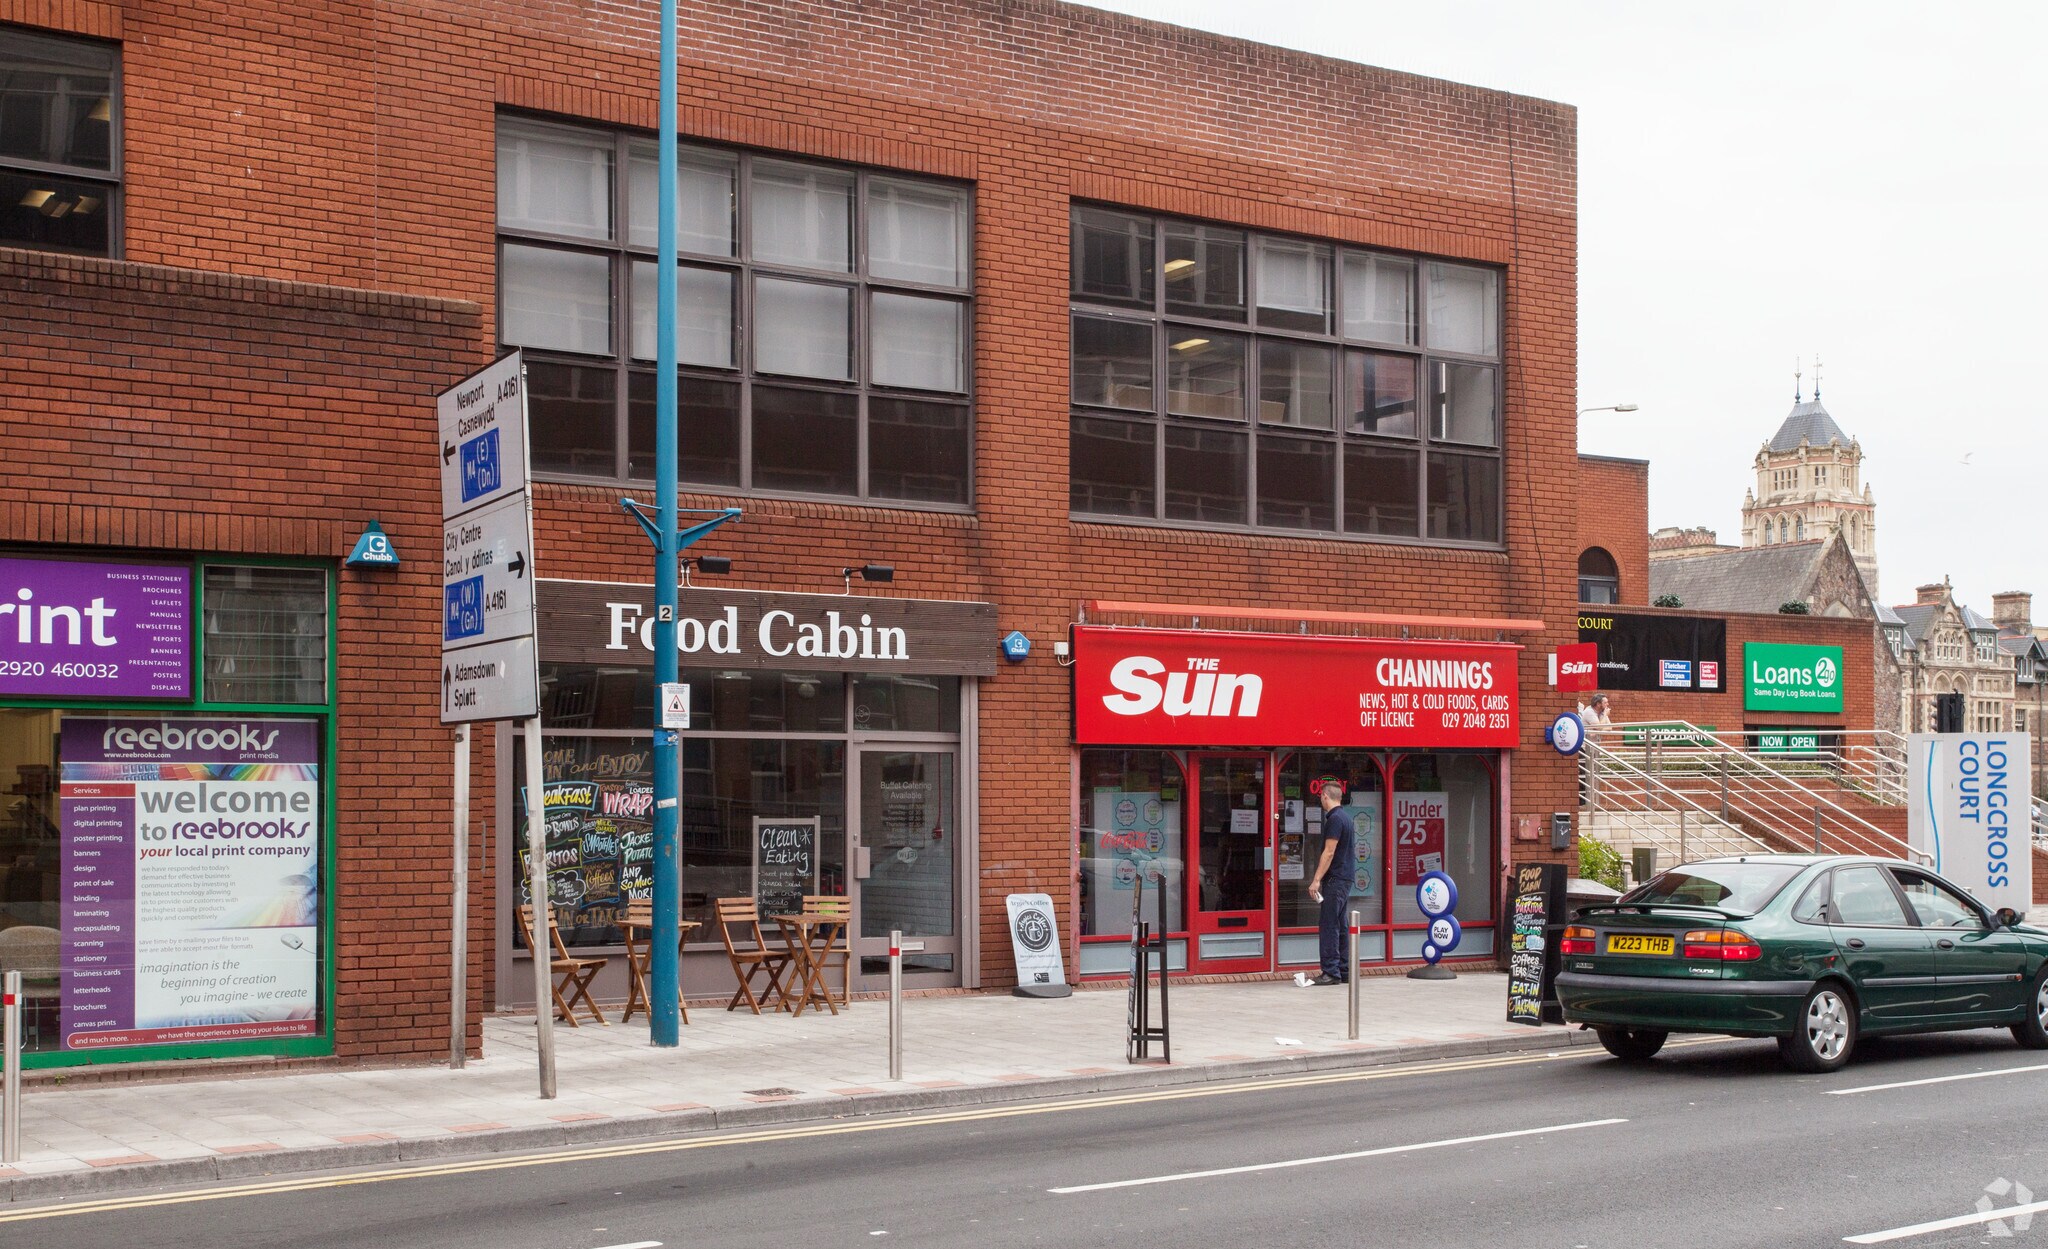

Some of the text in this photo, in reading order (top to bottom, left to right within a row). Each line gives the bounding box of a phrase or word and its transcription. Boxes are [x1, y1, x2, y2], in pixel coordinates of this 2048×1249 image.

[457, 381, 484, 411] Newport
[458, 402, 495, 437] Casnewydd
[445, 525, 482, 551] City Centre
[362, 552, 393, 561] Chubb
[445, 549, 493, 578] Canol y ddinas
[142, 574, 182, 582] STATIONERY
[662, 607, 671, 619] 2
[1578, 616, 1613, 630] COURT
[758, 609, 909, 659] Cabin
[51, 663, 118, 678] 460032
[454, 660, 496, 682] Adamsdown
[1187, 658, 1220, 670] THE
[1560, 663, 1592, 675] Sun
[1376, 658, 1493, 689] CHANNINGS
[1753, 660, 1812, 685] Loans
[1102, 656, 1263, 717] Sun
[1754, 688, 1836, 698] Same Day Log Book Loans
[454, 686, 476, 709] Splott
[1359, 693, 1509, 711] NEWS, HOT & COLD FOODS, CARDS
[1360, 712, 1510, 729] OFF LICENCE 029 2048 2351
[103, 723, 279, 751] reebrooks
[1761, 736, 1816, 747] NOW OPEN
[239, 752, 256, 760] print
[257, 752, 279, 760] media
[570, 751, 650, 777] and ENJOY
[902, 781, 932, 791] Catering
[1959, 741, 1980, 824] COURT
[141, 783, 310, 813] welcome
[890, 791, 922, 799] Available
[73, 805, 117, 813] plan printing
[603, 792, 653, 816] WRAP
[1398, 800, 1442, 818] Under
[1987, 741, 2009, 888] LONGCROSS
[73, 820, 123, 828] digital printing
[141, 818, 310, 840] to reebrooks
[73, 834, 123, 843] poster printing
[761, 828, 801, 849] Clean
[140, 845, 310, 860] your local print company
[73, 865, 96, 873] design
[766, 850, 808, 873] Eating
[1519, 867, 1542, 884] FOOD
[73, 880, 92, 888] point
[73, 895, 100, 903] binding
[73, 910, 109, 918] laminating
[73, 924, 120, 932] encapsulating
[1433, 932, 1449, 940] NOW
[73, 940, 104, 948] scanning
[1613, 936, 1669, 952] W223 THB
[73, 955, 107, 963] stationery
[140, 959, 240, 975] imagination is the
[1689, 966, 1715, 974] Laguna
[73, 986, 111, 994] letterheads
[161, 974, 277, 990] beginning of creation
[1511, 981, 1539, 997] EAT-IN
[180, 988, 308, 1006] you imagine we create
[73, 1003, 107, 1011] brochures
[97, 1020, 116, 1028] prints
[74, 1037, 88, 1045] and
[168, 1031, 183, 1039] have
[196, 1029, 231, 1039] experience
[240, 1026, 257, 1036] bring
[257, 1027, 272, 1036] your
[272, 1025, 289, 1033] ideas
